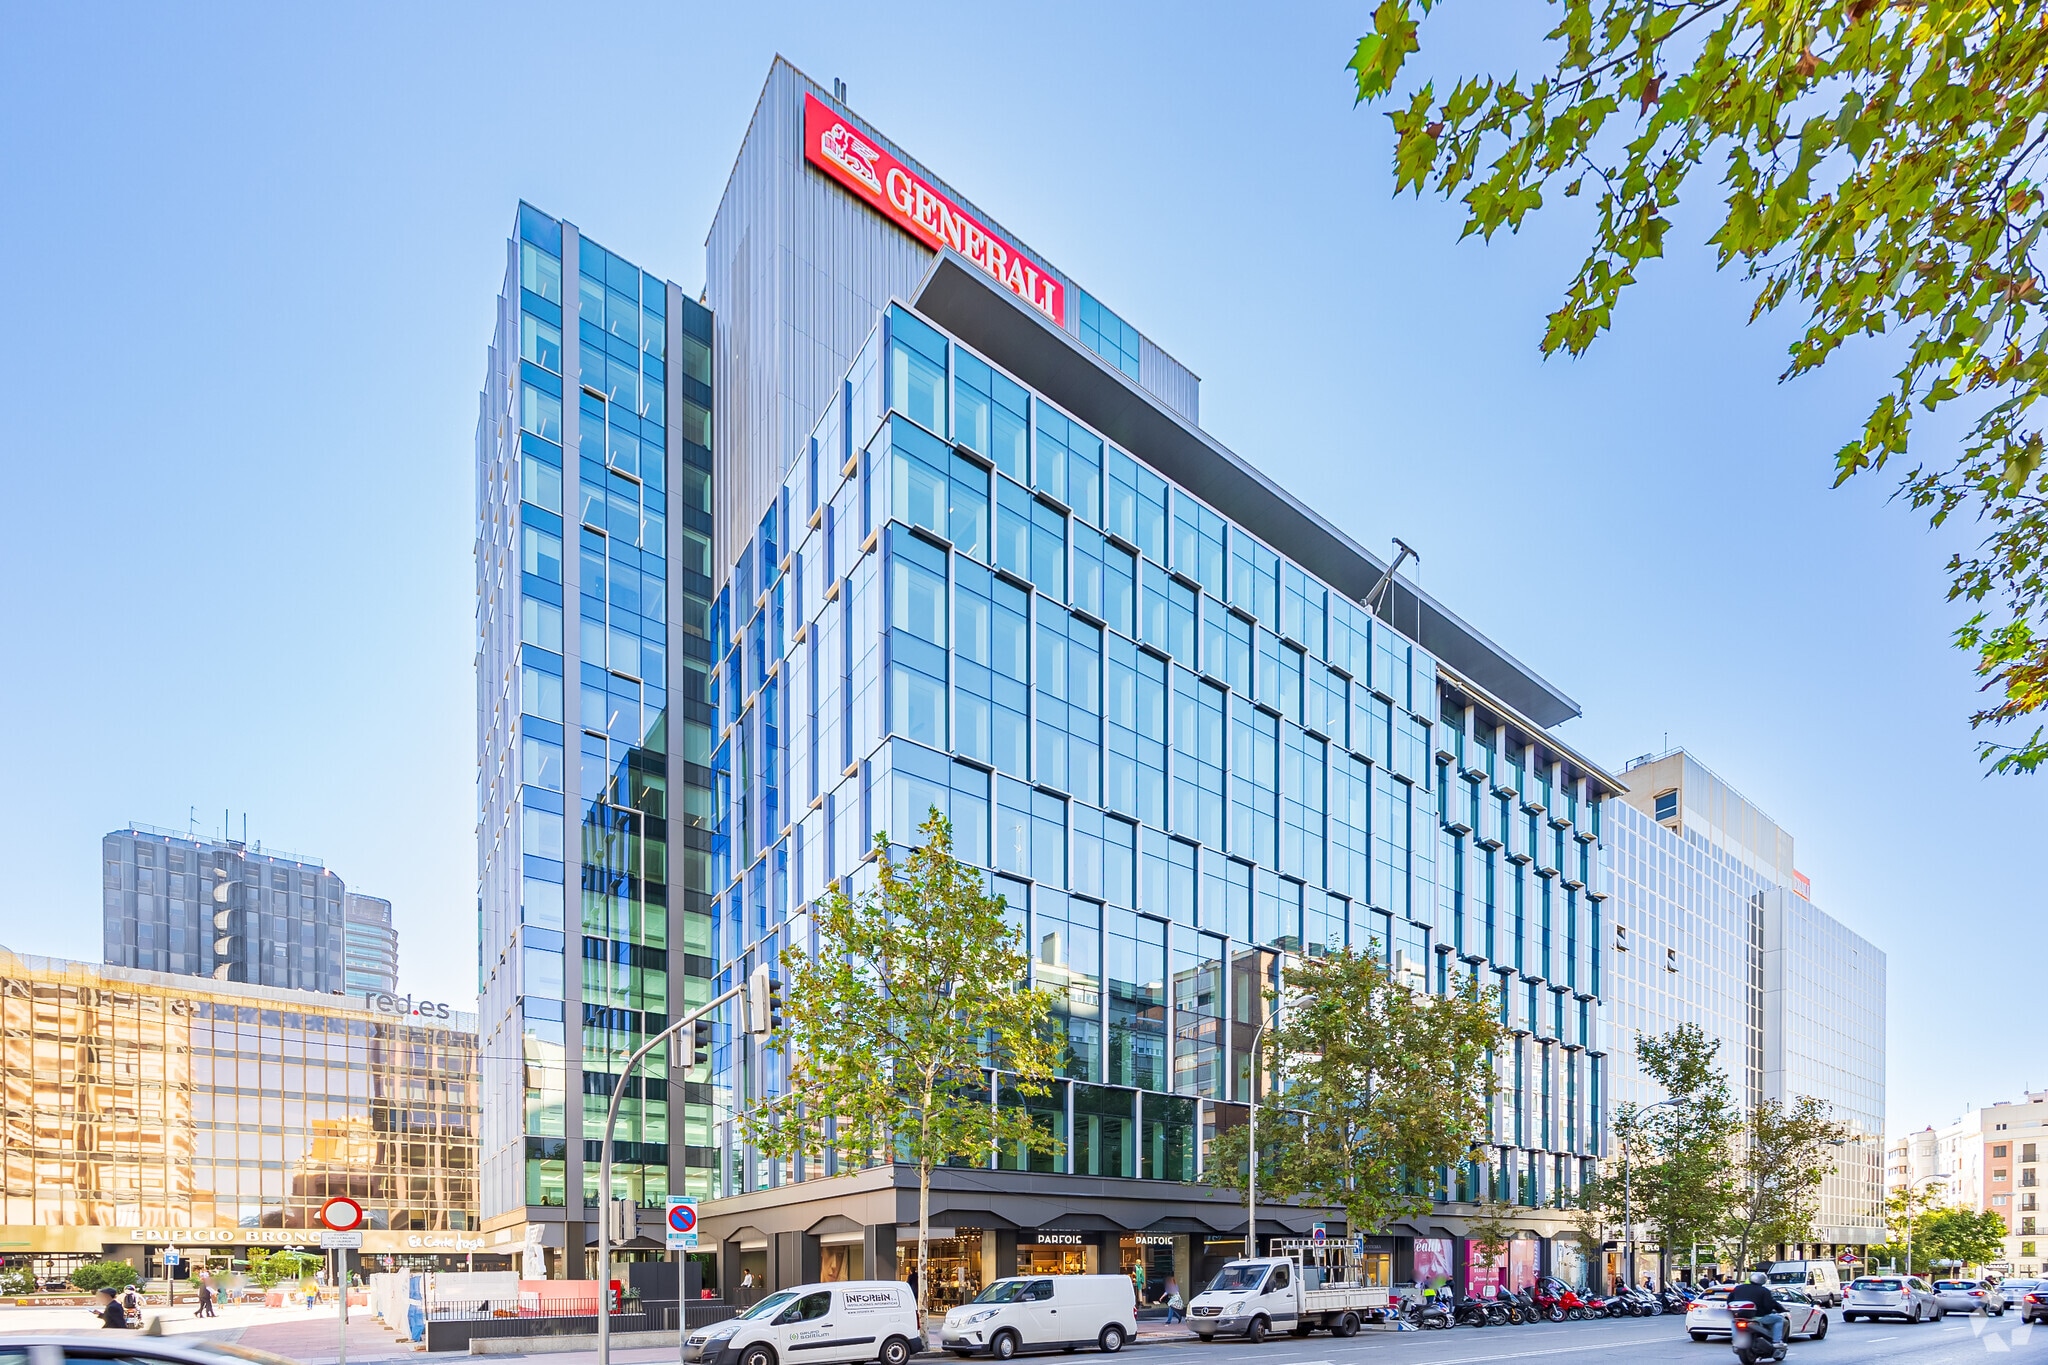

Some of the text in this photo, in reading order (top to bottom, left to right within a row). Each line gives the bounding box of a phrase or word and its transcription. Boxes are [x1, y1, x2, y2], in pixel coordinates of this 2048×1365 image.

[885, 167, 1057, 321] GENERALI
[365, 992, 450, 1019] red.es
[130, 1229, 321, 1243] EDIFICIO BRONC
[408, 1235, 422, 1248] El
[423, 1235, 454, 1248] Corte
[1037, 1234, 1082, 1244] PARFOIS
[1135, 1236, 1173, 1246] PARFOIS
